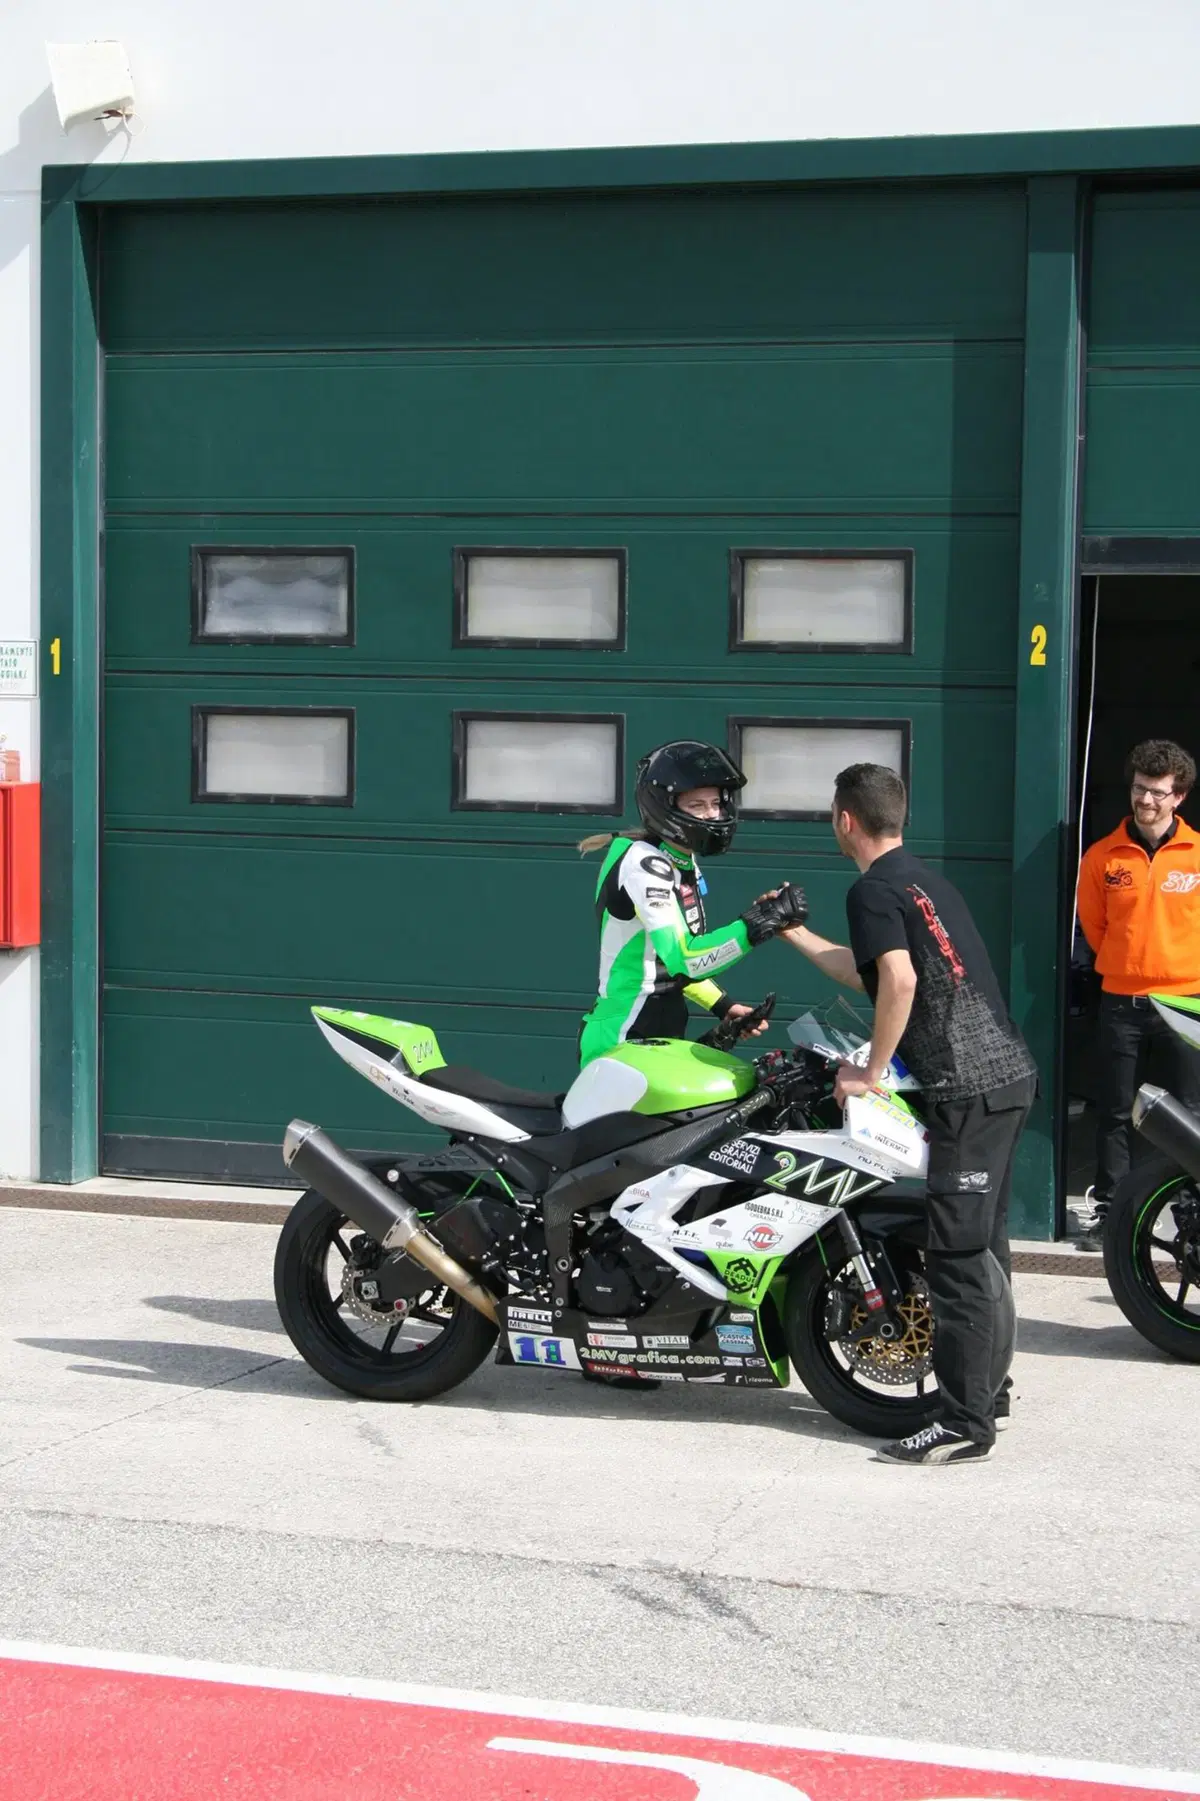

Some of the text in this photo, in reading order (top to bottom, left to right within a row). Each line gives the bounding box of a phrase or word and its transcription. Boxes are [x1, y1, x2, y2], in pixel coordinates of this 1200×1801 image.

[50, 638, 61, 675] 1
[1030, 625, 1047, 666] 2
[720, 1144, 759, 1164] GRAFICI
[731, 1139, 761, 1155] SERVIZI
[708, 1150, 753, 1174] EDITORIALI
[763, 1151, 882, 1207] 2MV
[508, 1306, 552, 1322] PIRELLI
[579, 1346, 720, 1365] 2MVgrafica.com
